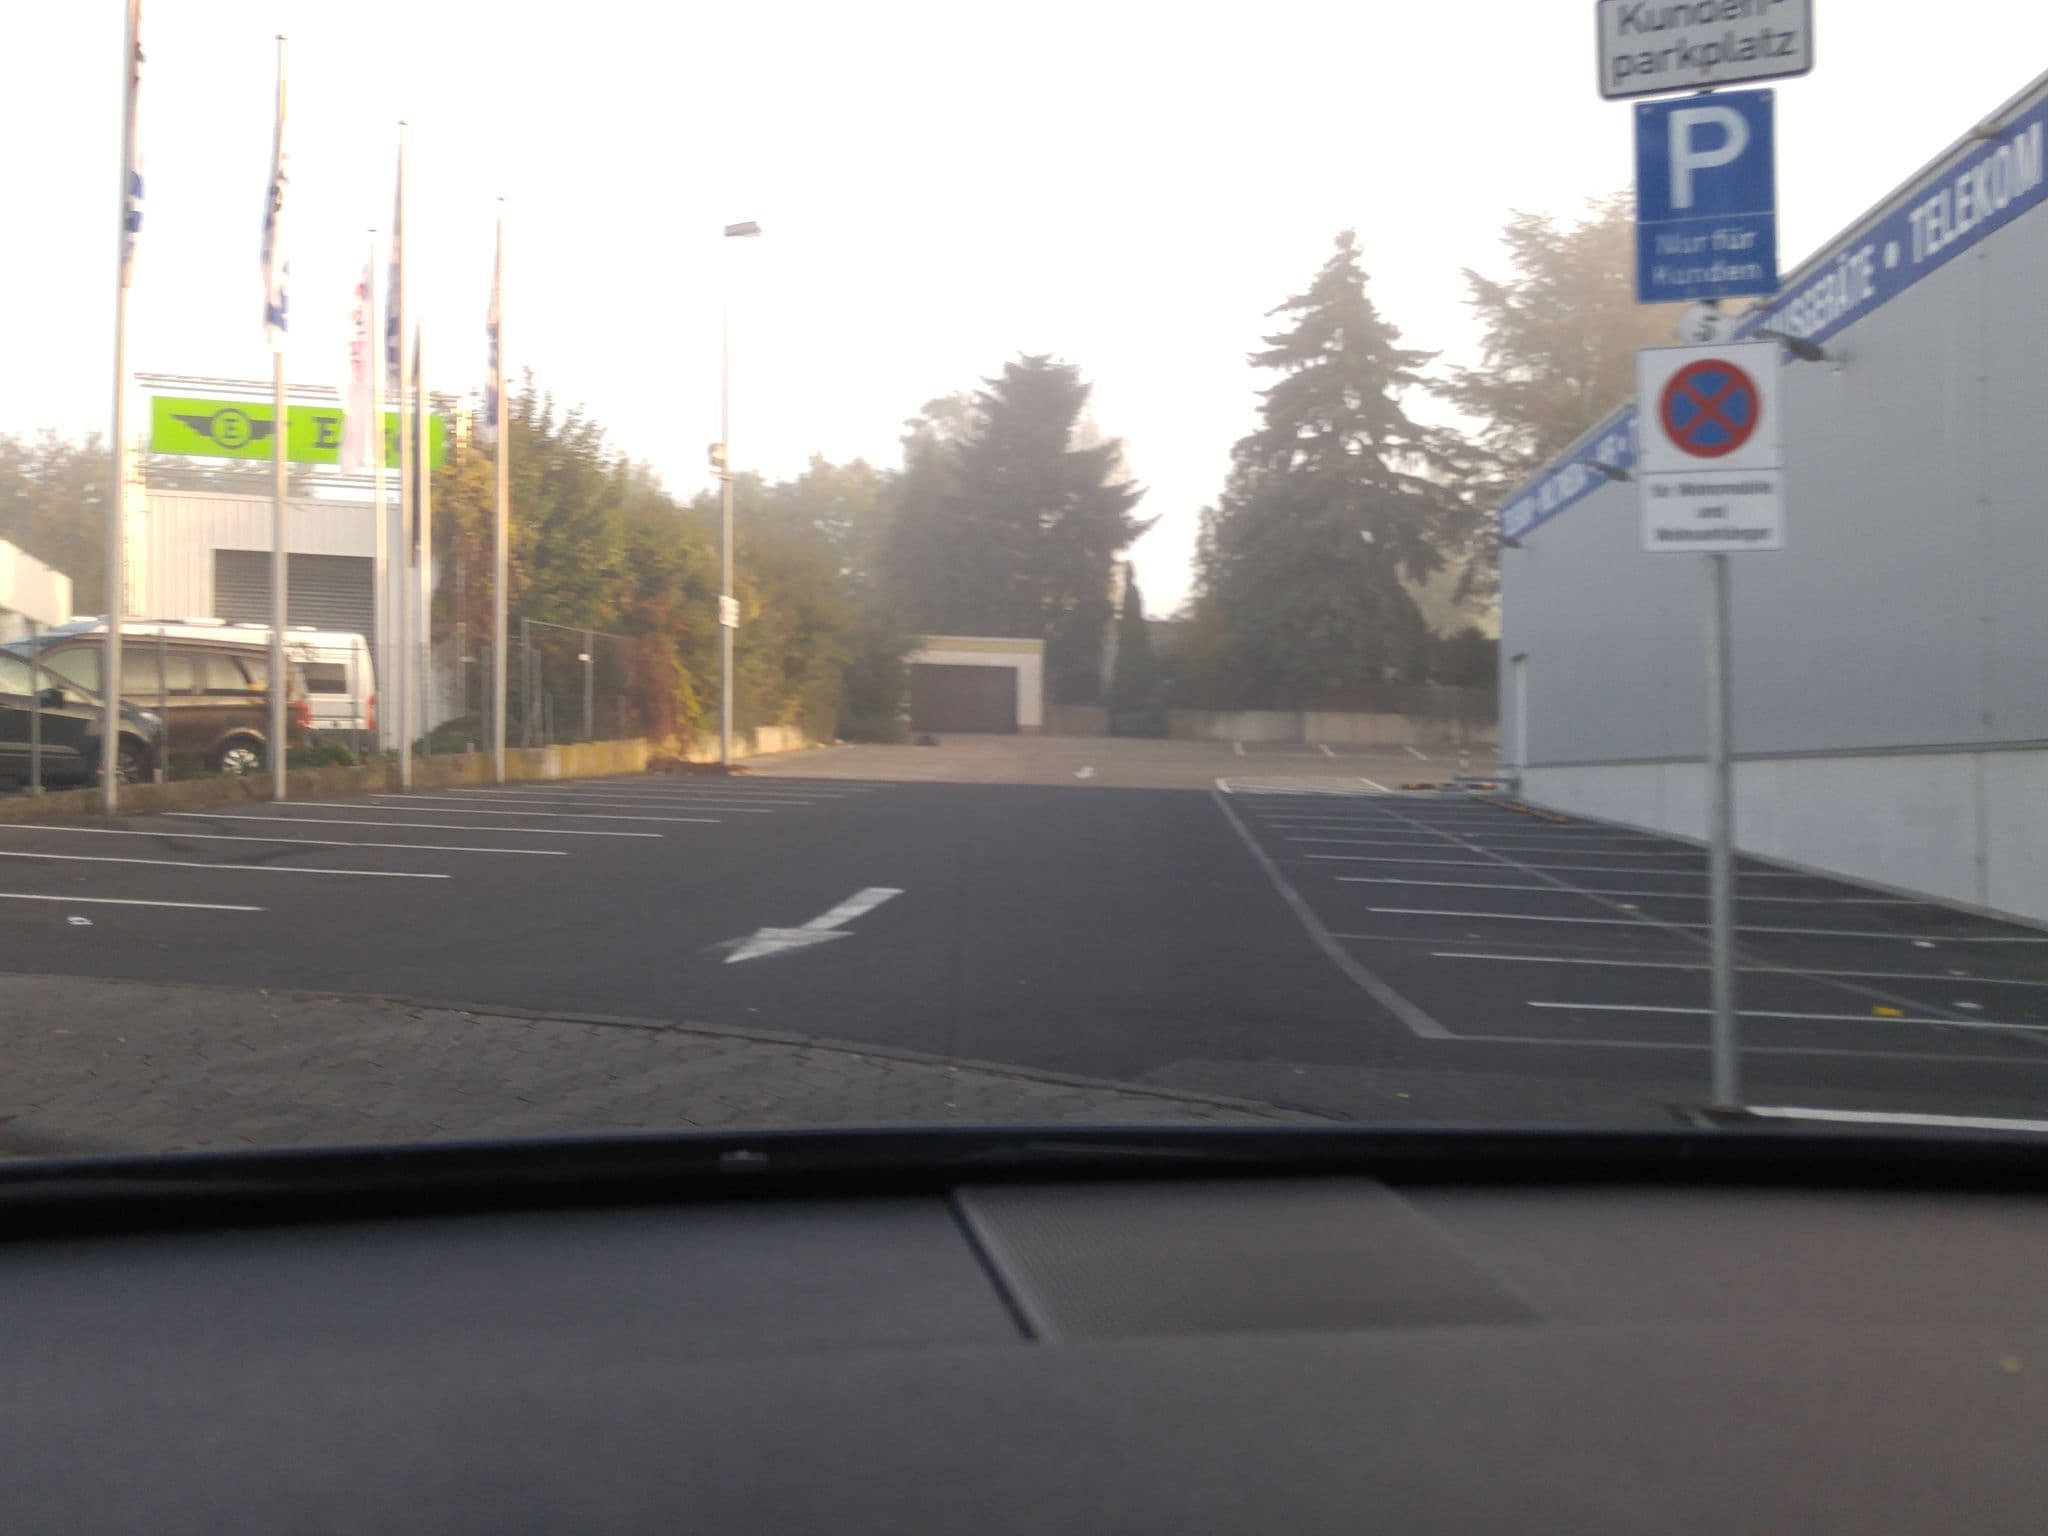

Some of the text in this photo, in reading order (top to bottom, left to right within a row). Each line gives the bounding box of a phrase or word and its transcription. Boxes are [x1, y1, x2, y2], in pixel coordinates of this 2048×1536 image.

[1613, 29, 1797, 87] parkplatz
[1668, 106, 1749, 209] P
[1908, 120, 2044, 264] TELEKOM
[1655, 227, 1757, 255] Nur für
[1652, 260, 1763, 286] Kunden
